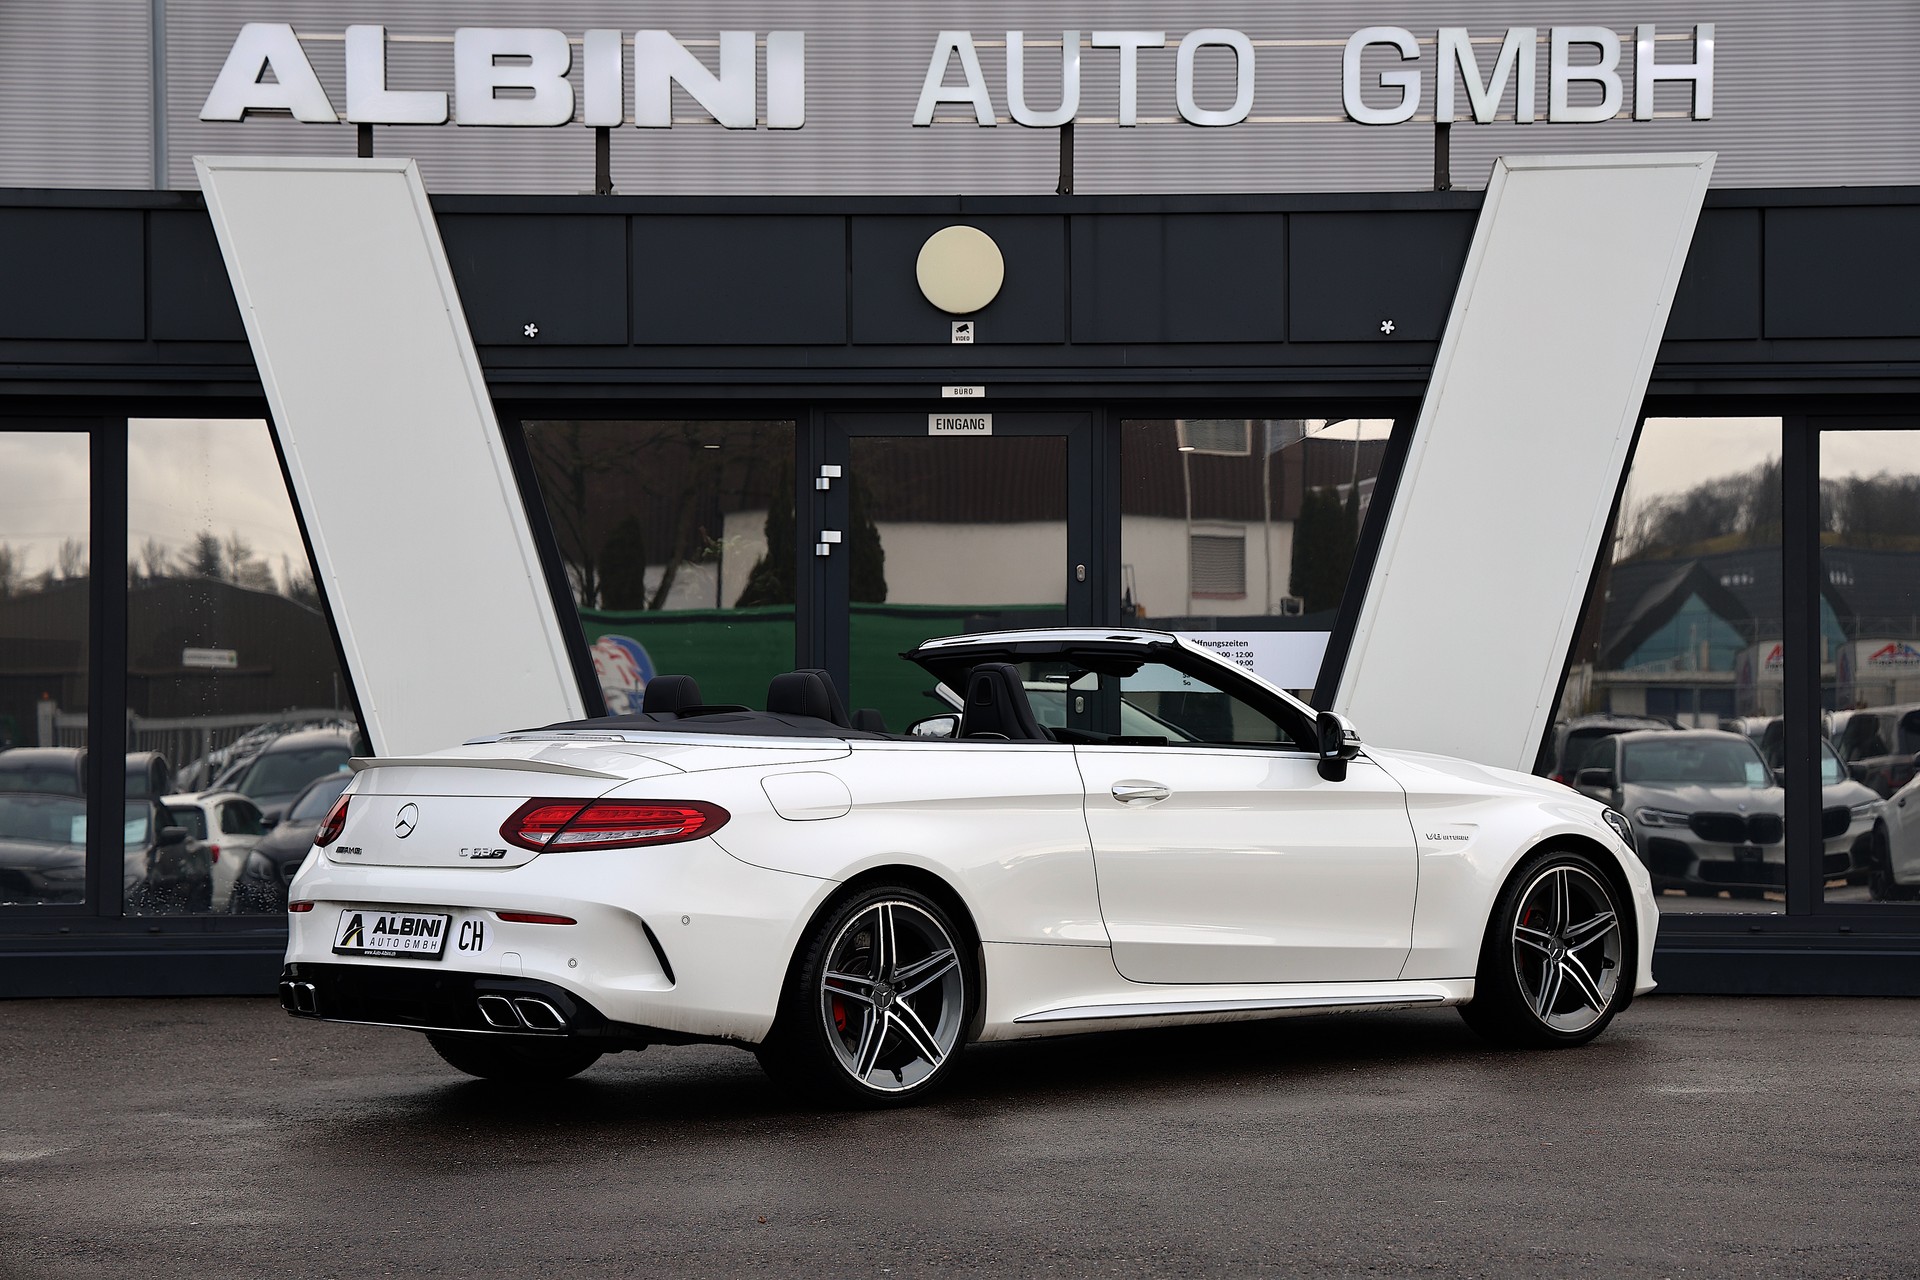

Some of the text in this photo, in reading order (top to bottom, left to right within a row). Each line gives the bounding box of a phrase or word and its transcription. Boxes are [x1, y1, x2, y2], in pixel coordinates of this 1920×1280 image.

[199, 22, 1716, 130] ALBINI AUTO GMBH
[954, 386, 973, 395] BÜRO
[936, 418, 985, 430] EINGANG
[459, 847, 469, 857] C
[372, 916, 442, 938] ALBINI
[458, 920, 484, 952] CH
[369, 937, 438, 950] AUTO GMBH
